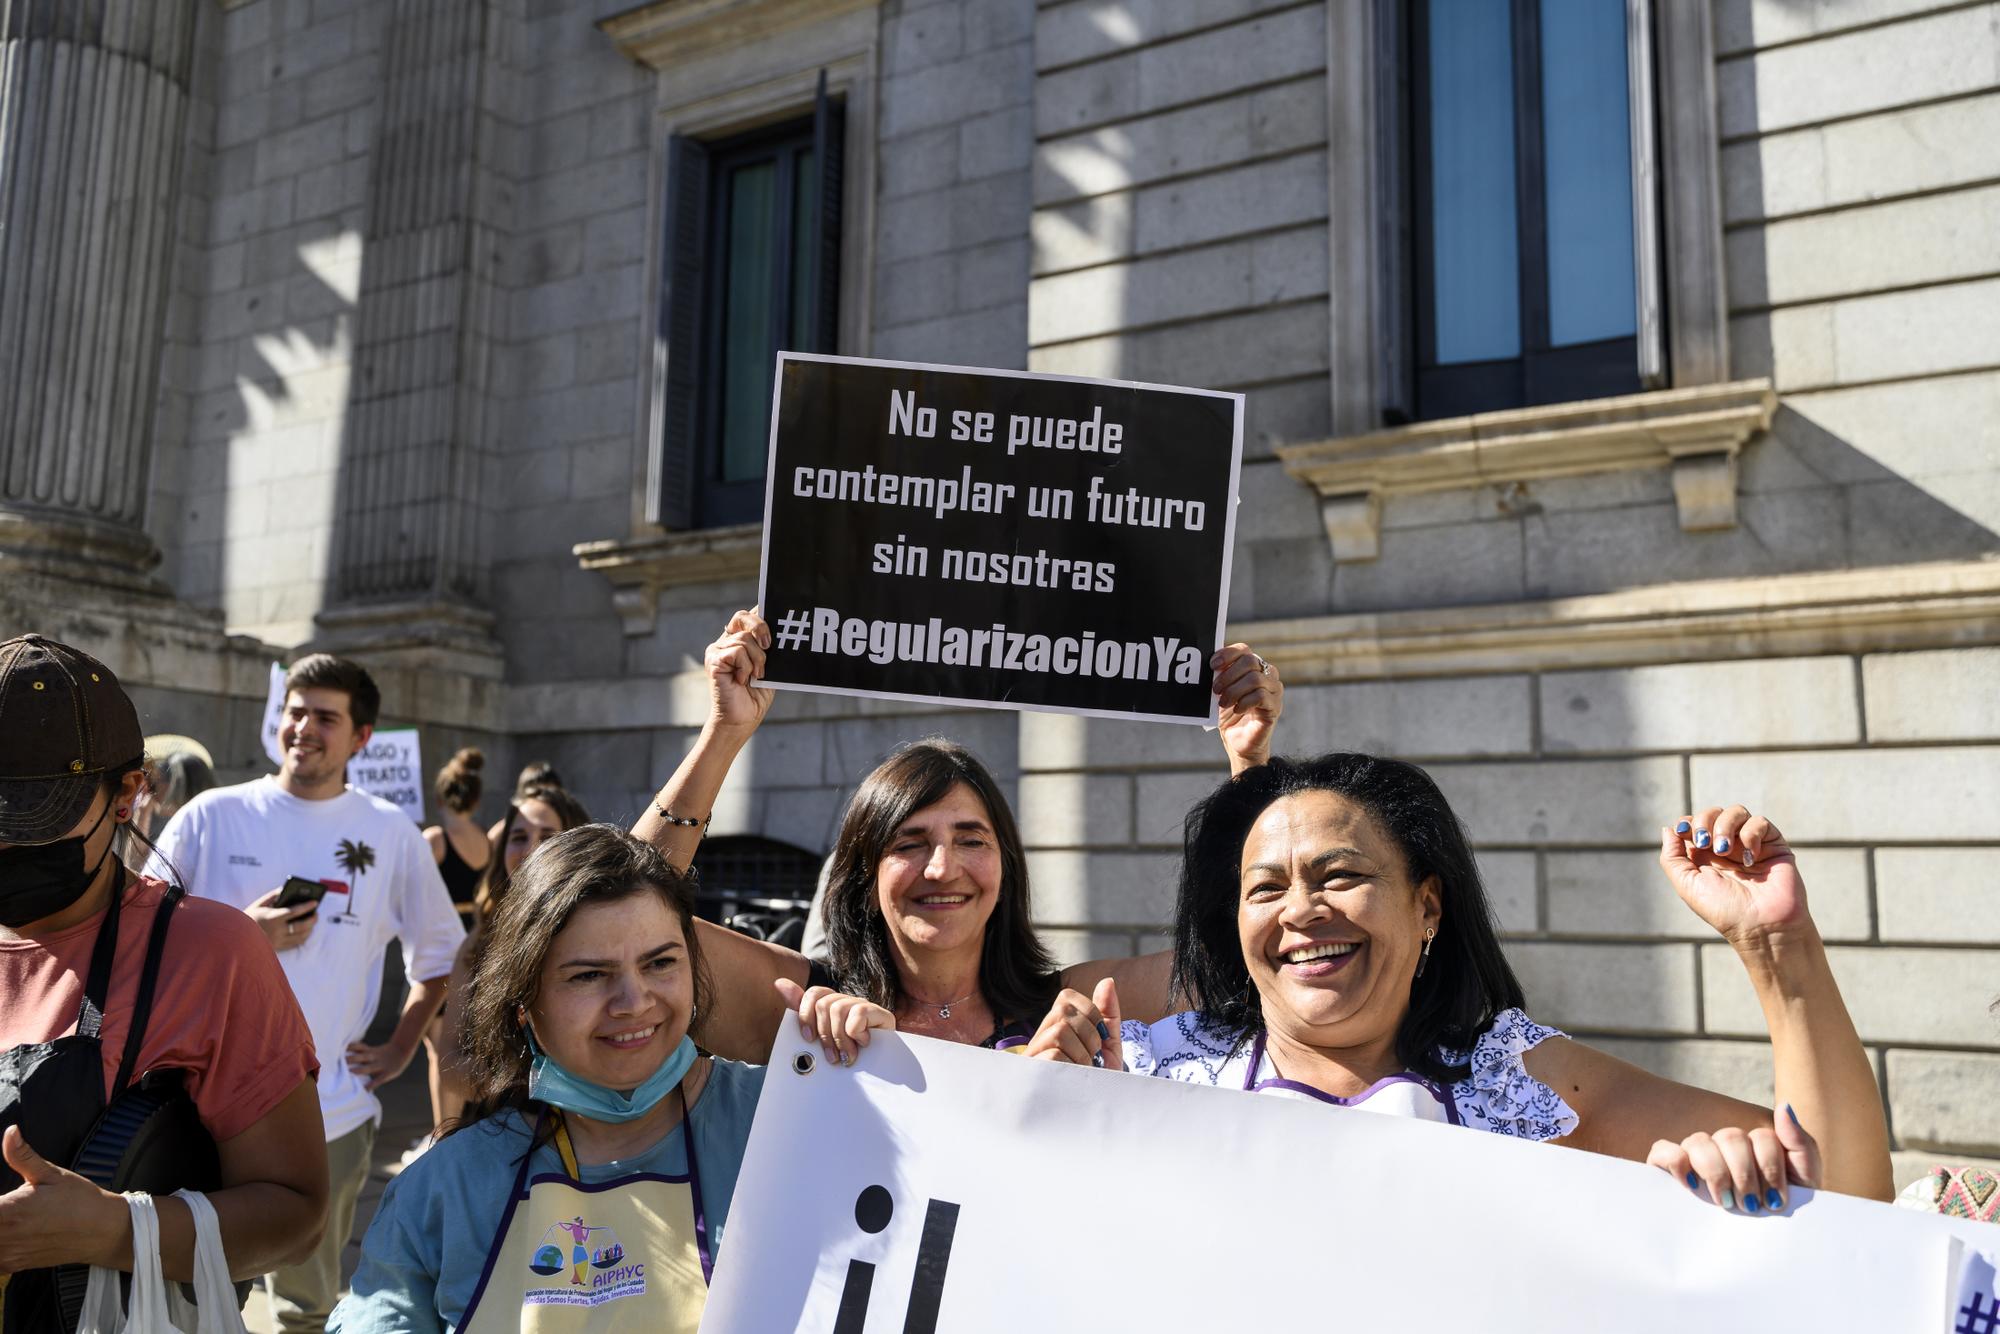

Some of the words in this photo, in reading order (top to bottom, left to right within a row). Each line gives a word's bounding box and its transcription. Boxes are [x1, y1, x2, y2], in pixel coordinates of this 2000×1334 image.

[888, 389, 937, 438] No
[950, 410, 995, 443] se
[1007, 405, 1123, 456] puede
[793, 464, 1016, 519] contemplar
[1027, 486, 1074, 520] un
[1087, 476, 1206, 531] futuro
[872, 534, 928, 577] sin
[941, 549, 1116, 593] nosotras
[776, 607, 1202, 685] #RegularizacionYa
[356, 744, 397, 761] AGO
[356, 766, 412, 784] TRATO
[593, 1264, 645, 1288] AIPHYC
[546, 1296, 567, 1304] Somos
